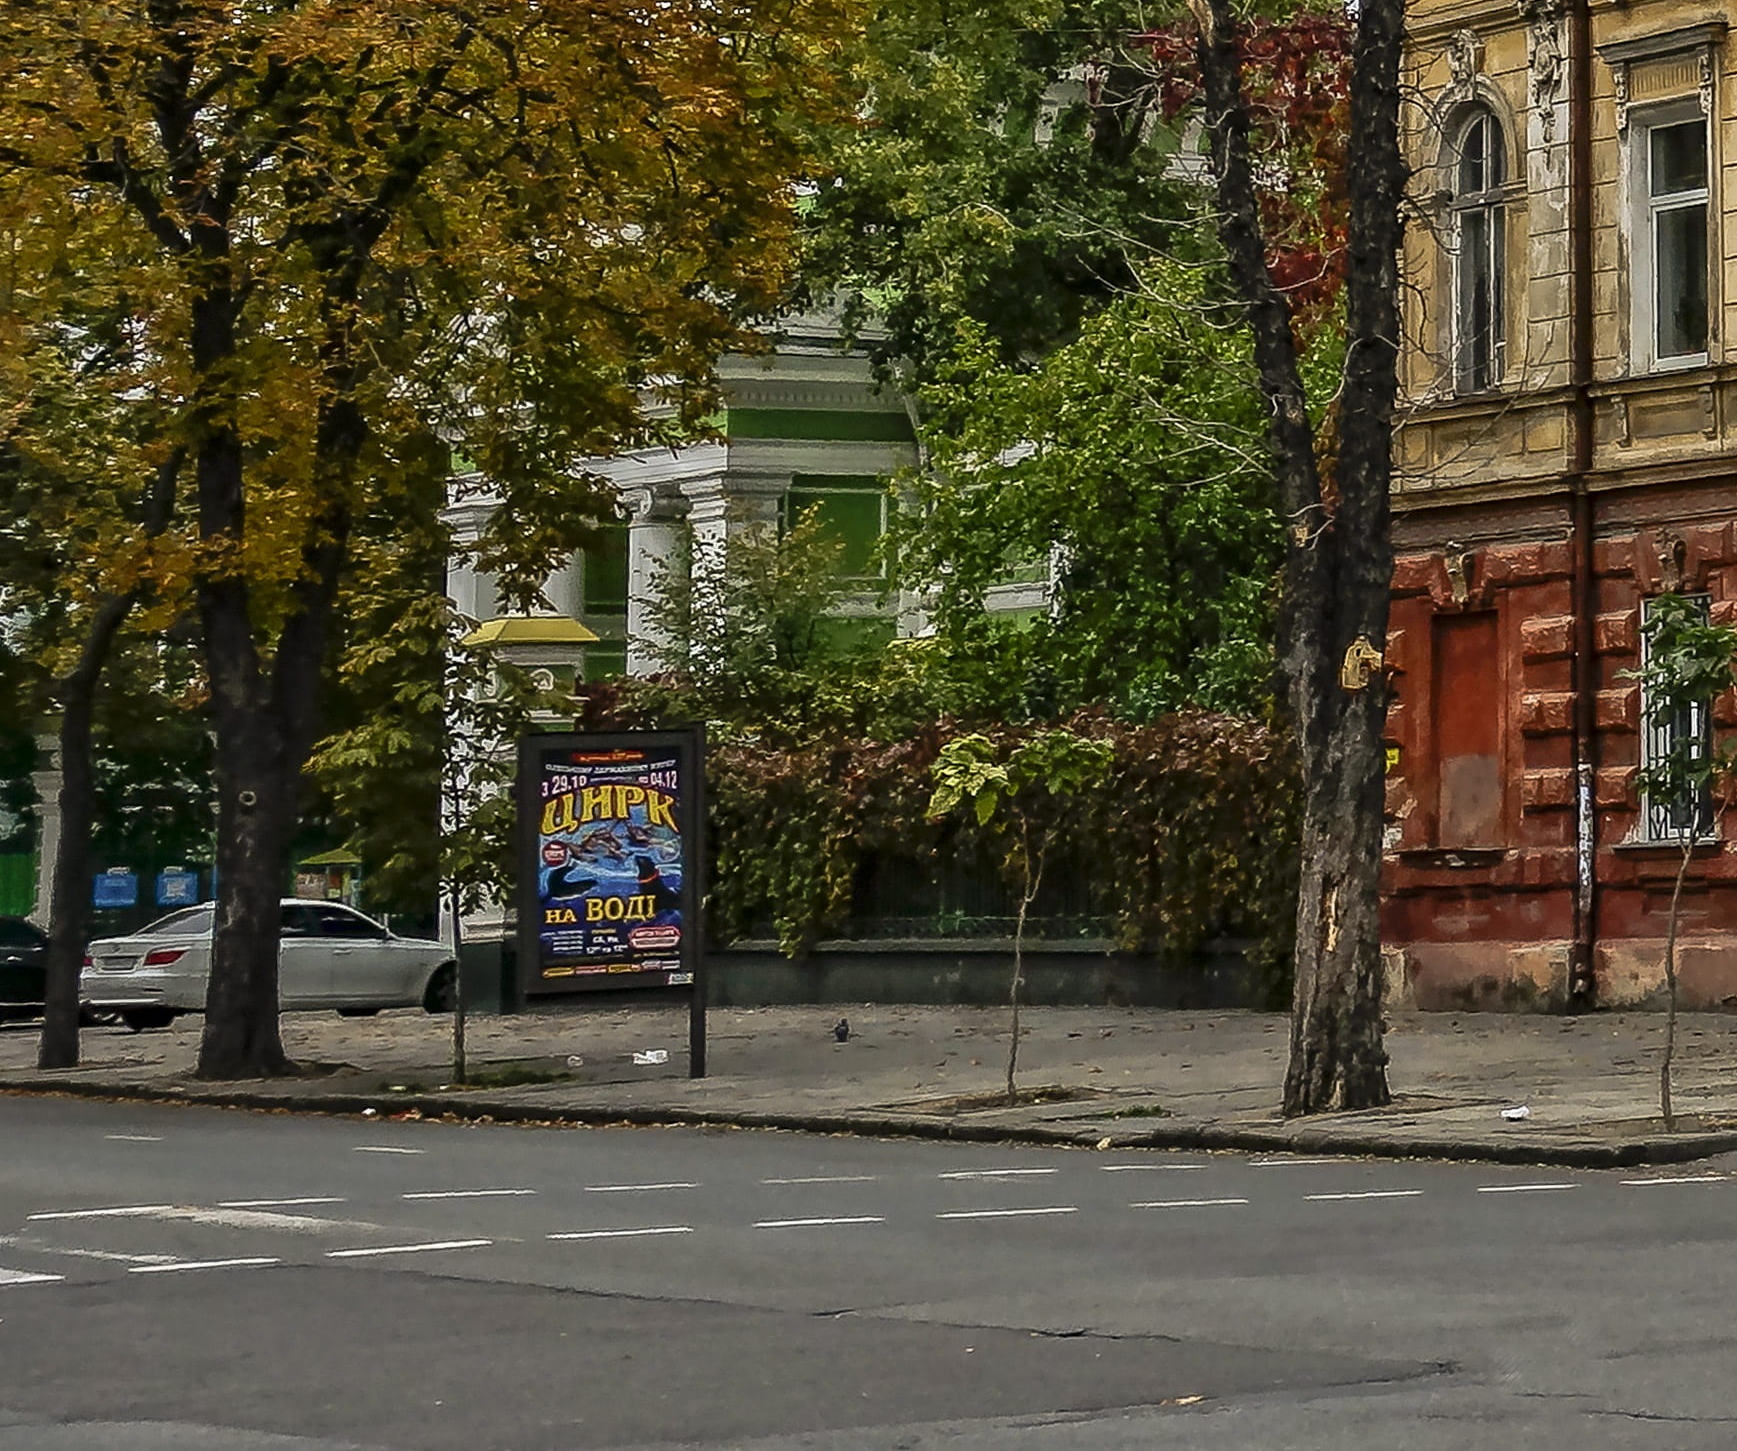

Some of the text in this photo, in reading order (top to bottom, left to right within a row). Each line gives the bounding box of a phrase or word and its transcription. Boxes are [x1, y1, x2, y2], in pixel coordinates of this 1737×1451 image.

[551, 774, 587, 795] 29.10
[650, 770, 677, 790] 04.12
[541, 784, 680, 835] ЦИРК
[545, 895, 657, 924] НА ВОДІ
